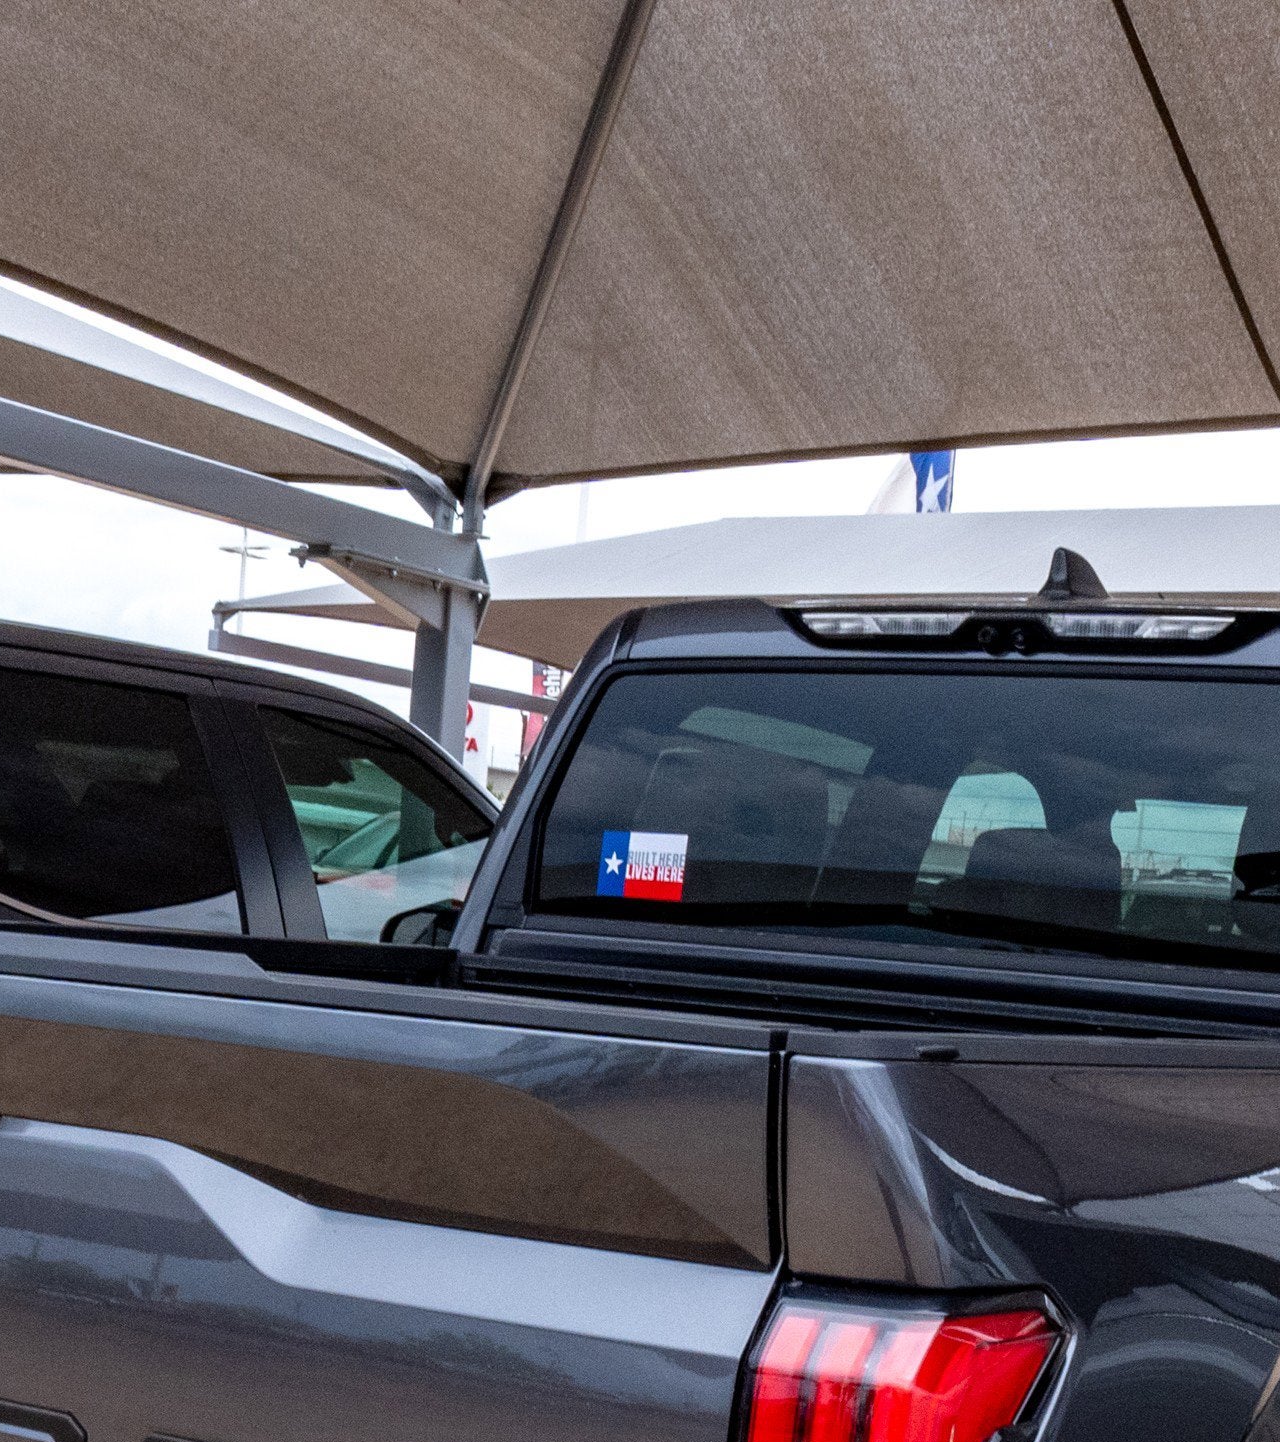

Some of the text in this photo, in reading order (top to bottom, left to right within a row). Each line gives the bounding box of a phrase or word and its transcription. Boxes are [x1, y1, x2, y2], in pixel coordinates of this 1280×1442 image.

[628, 850, 686, 869] BUILT HERE
[625, 864, 685, 883] LIVES HERE
